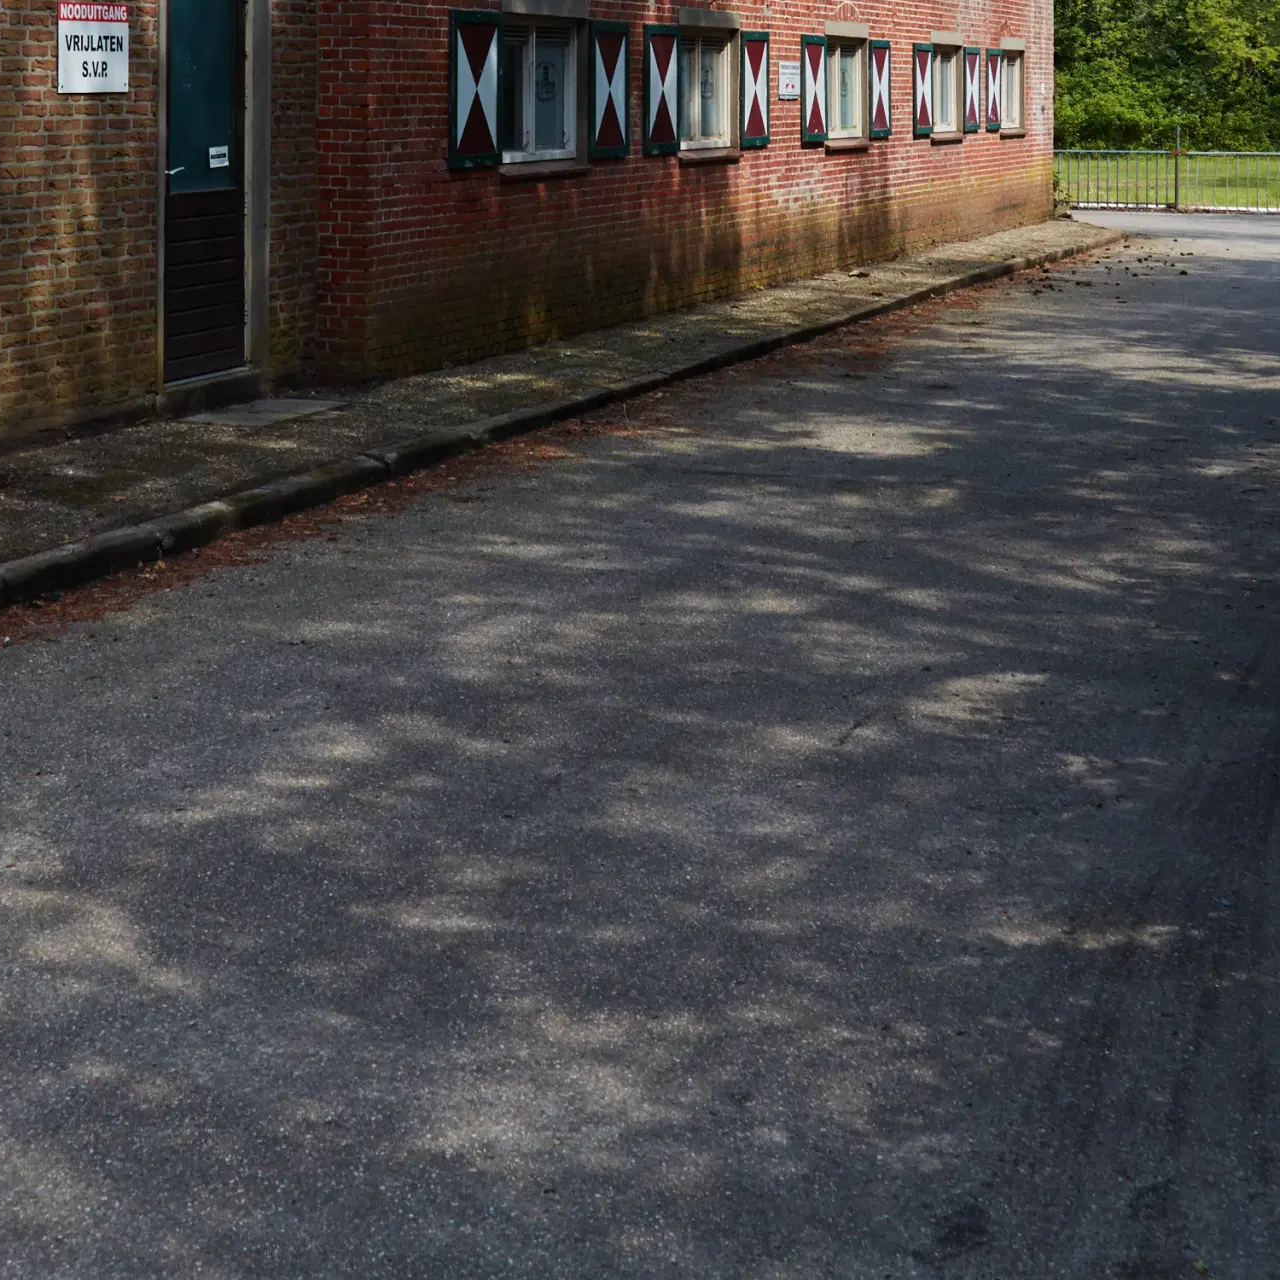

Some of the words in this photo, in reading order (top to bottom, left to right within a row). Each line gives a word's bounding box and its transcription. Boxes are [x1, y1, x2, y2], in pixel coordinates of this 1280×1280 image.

[60, 3, 127, 21] NOODUITGANG
[65, 34, 124, 52] VRIJLATEN
[82, 61, 108, 78] S.V.P.
